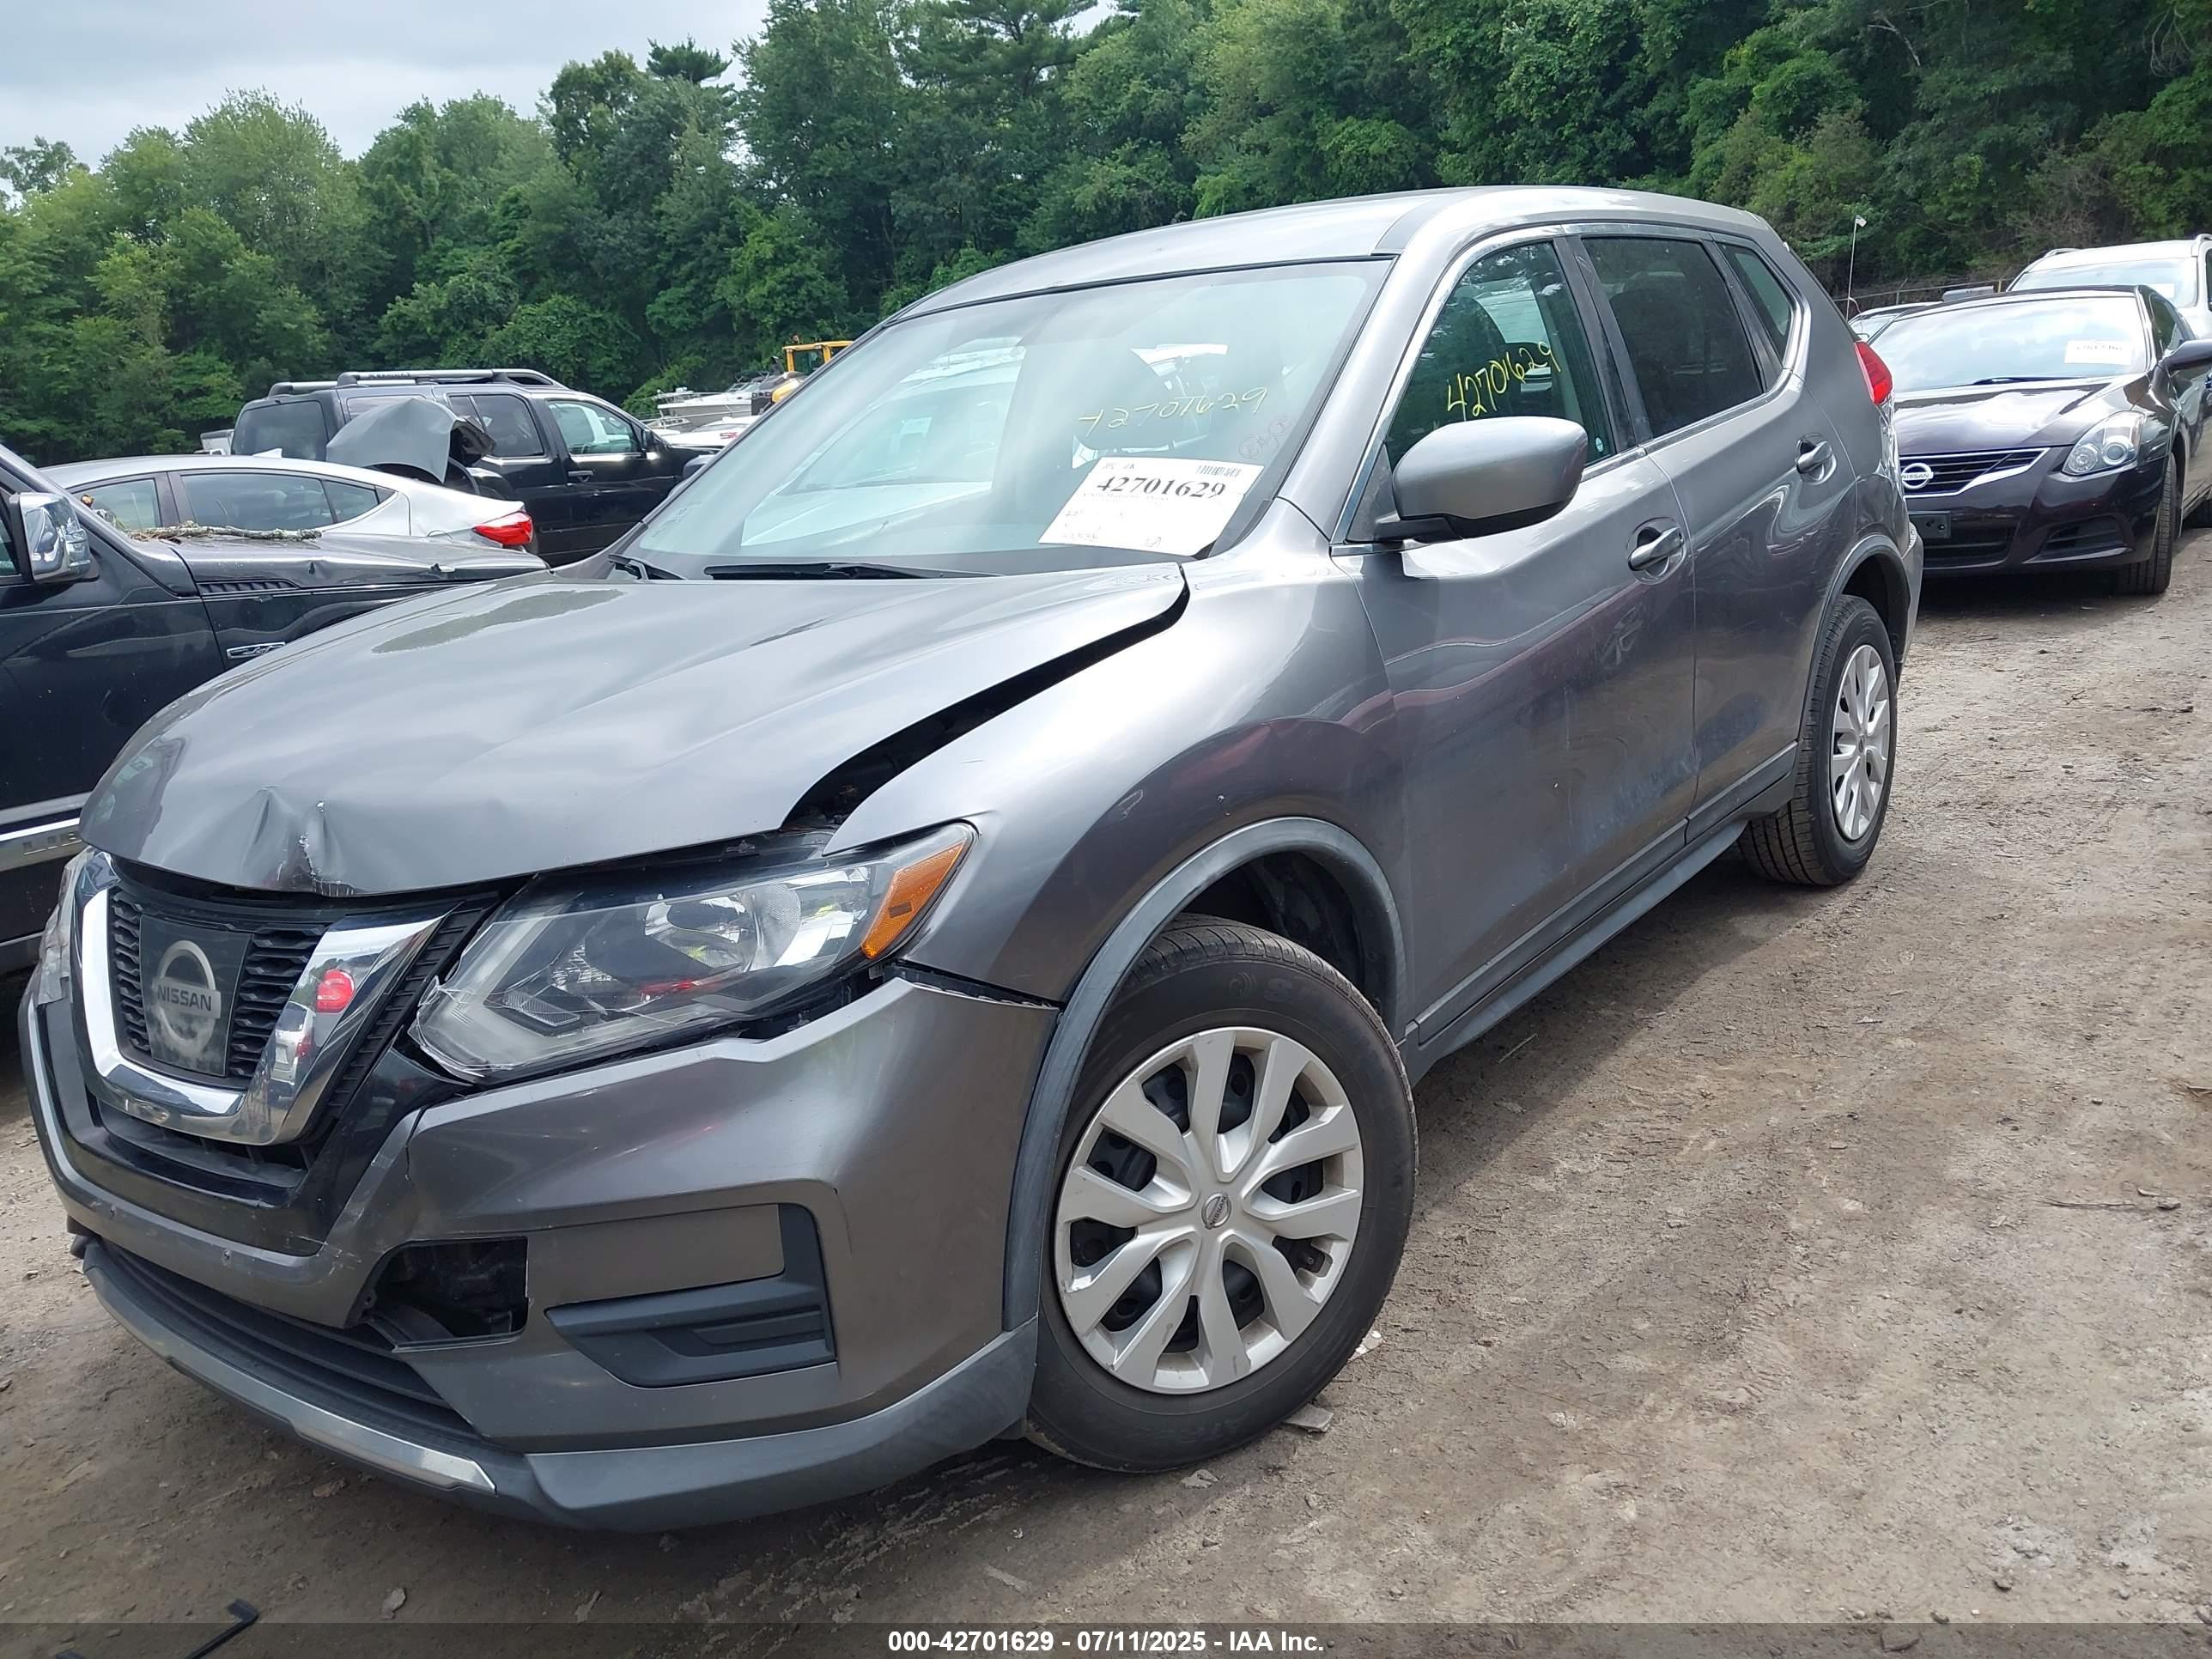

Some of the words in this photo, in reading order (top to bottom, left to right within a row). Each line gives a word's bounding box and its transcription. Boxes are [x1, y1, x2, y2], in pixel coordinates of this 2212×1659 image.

[1447, 341, 1561, 421] 42701629
[1079, 386, 1268, 438] 42701629
[1097, 476, 1226, 499] 42701629
[157, 984, 212, 1012] NISSAN
[1209, 1195, 1227, 1226] NISSAN
